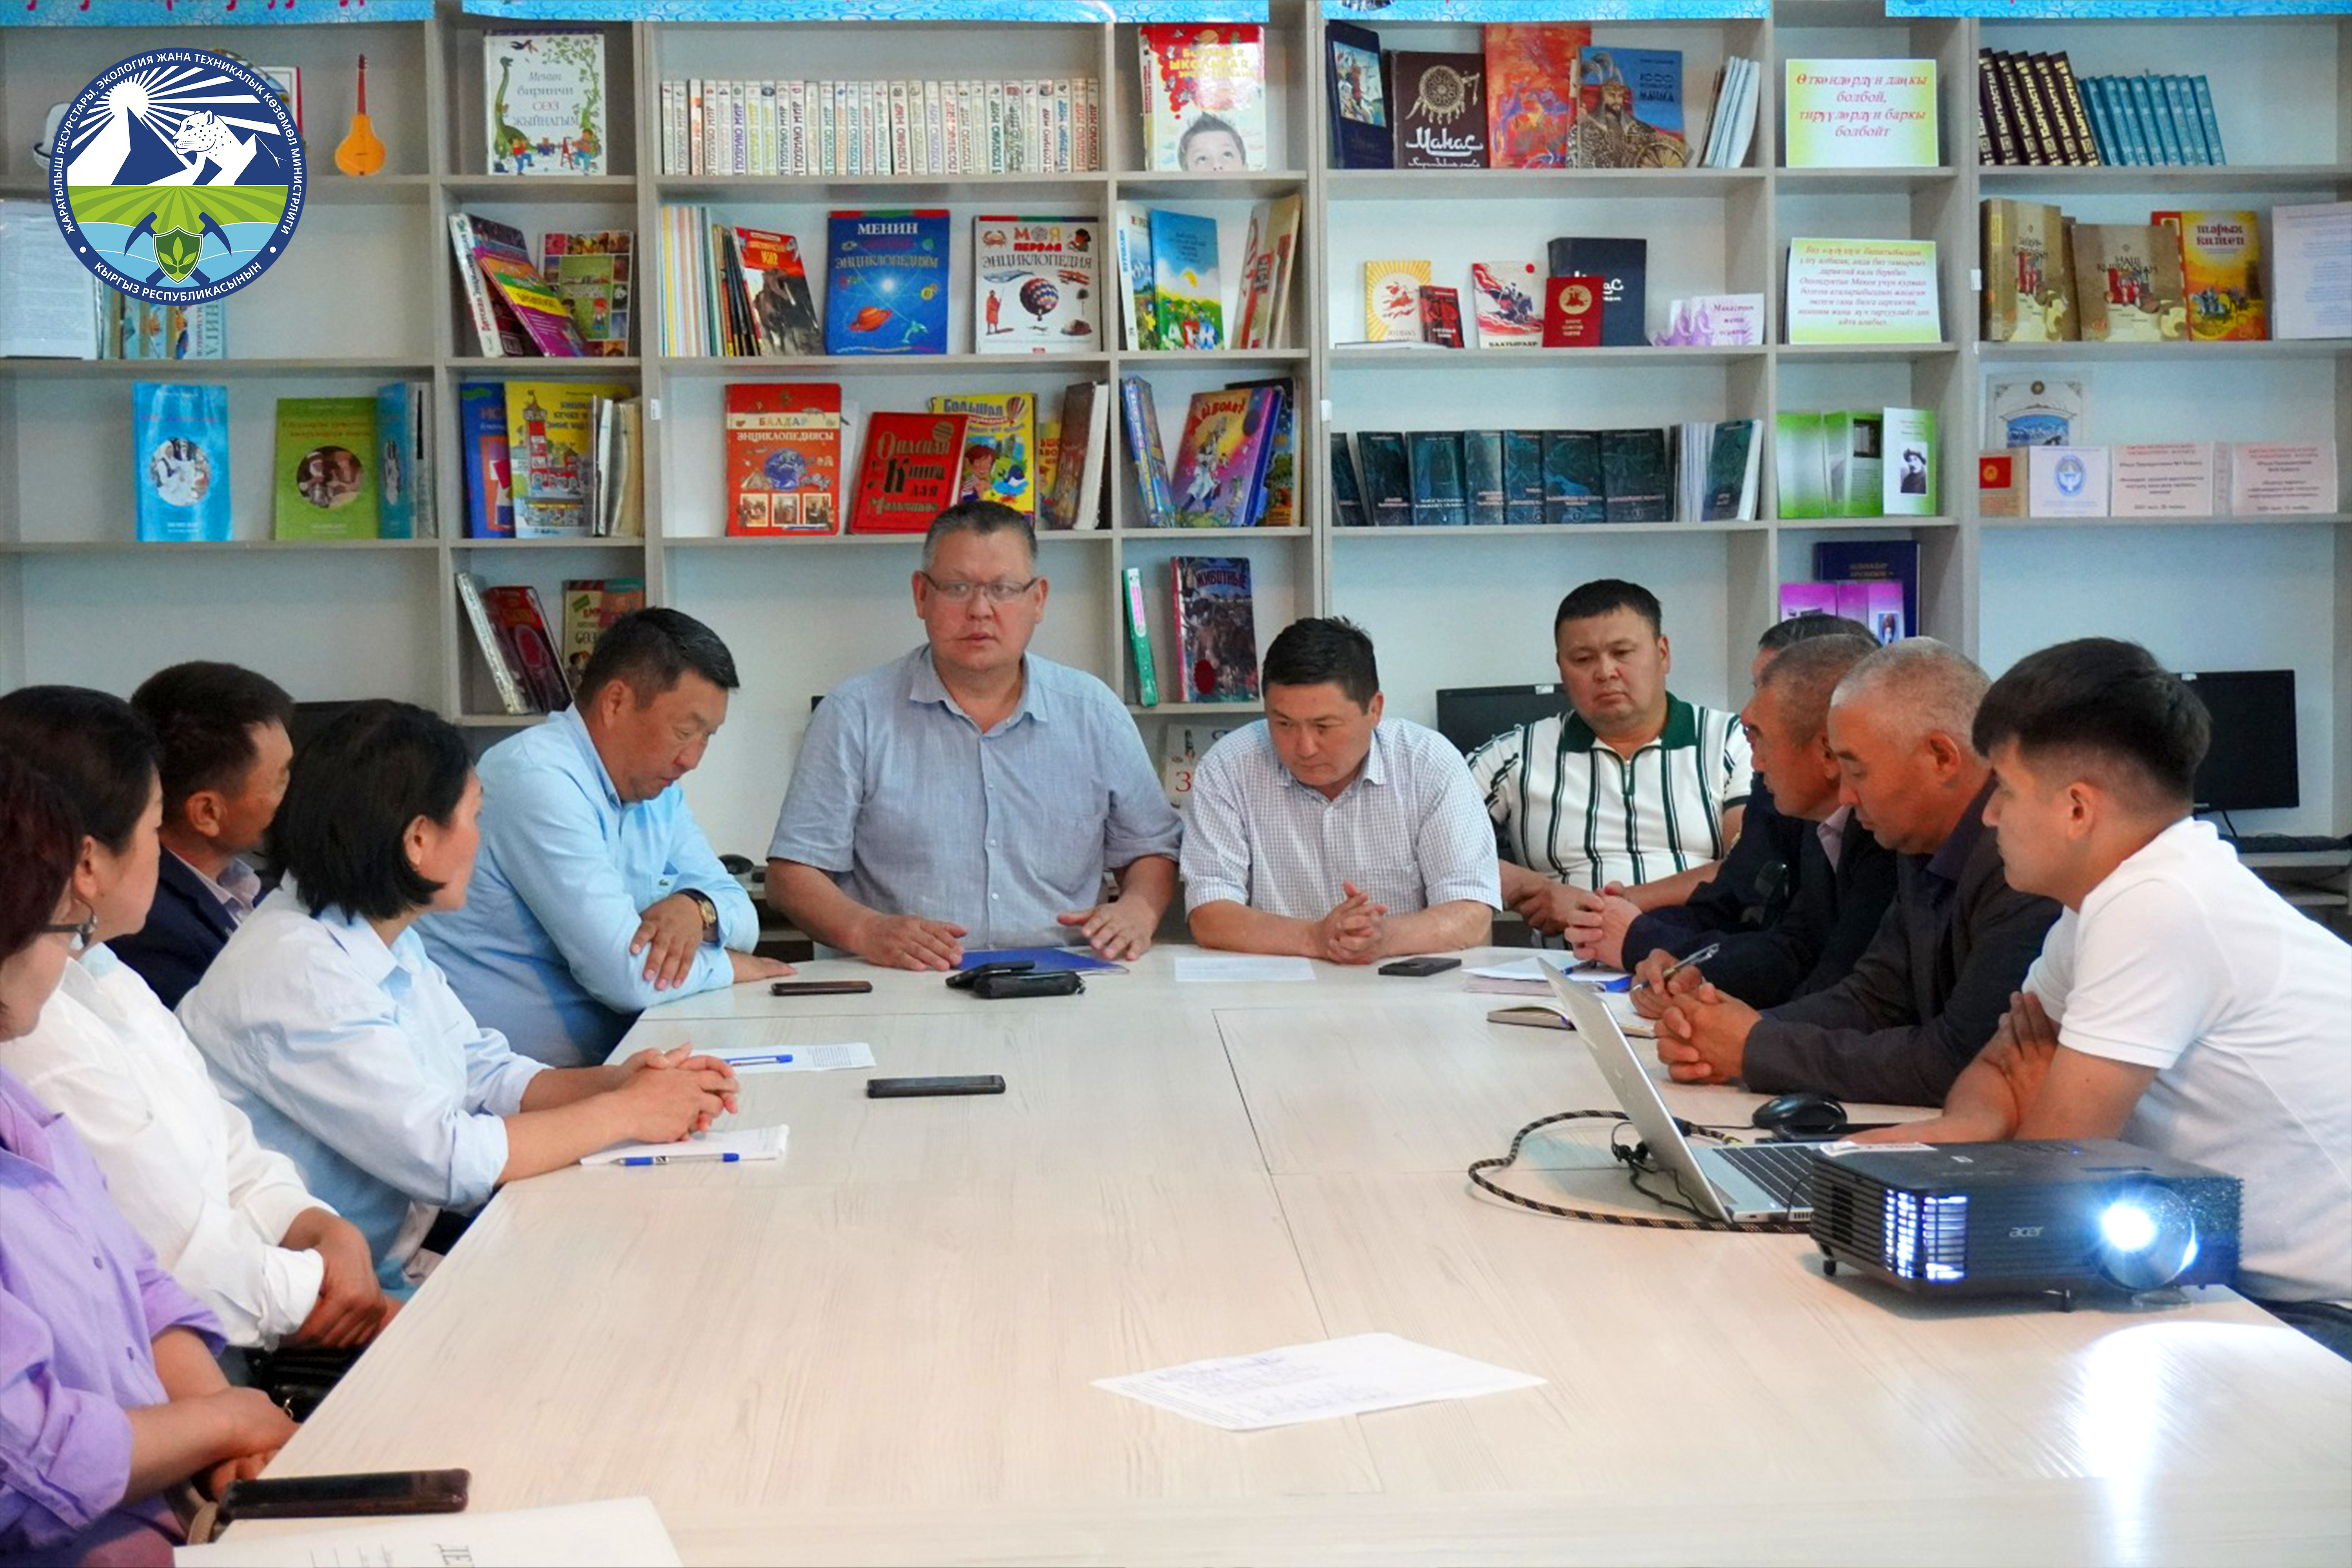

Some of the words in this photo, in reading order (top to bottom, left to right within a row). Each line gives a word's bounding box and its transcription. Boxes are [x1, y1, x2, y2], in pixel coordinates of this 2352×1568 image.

[734, 103, 742, 125] МИР
[793, 102, 803, 123] МИР
[823, 107, 832, 126] МИР
[849, 106, 857, 126] МИР
[894, 103, 904, 124] МИР
[1835, 126, 1891, 138] болбойт
[735, 129, 744, 169] ПОЗНАЮ
[780, 129, 788, 167] ПОЗНАЮ
[793, 127, 804, 167] ПОЗНАЮ
[824, 130, 833, 166] ПОЗНАЮ
[849, 129, 858, 167] ПОЗНАЮ
[897, 128, 906, 169] ПОЗНАЮ
[991, 126, 1002, 167] ПОЗНАЮ
[1088, 127, 1098, 164] ПОЗНАЮ
[857, 223, 918, 235] МЕНИН
[1013, 242, 1062, 252] ПЕРВАЯ
[982, 254, 1092, 269] ЭНЦИКЛОПЕДИЯ
[737, 432, 834, 442] ЭНЦИКЛОПЕДИЯСЫ
[2009, 1225, 2044, 1238] acer
